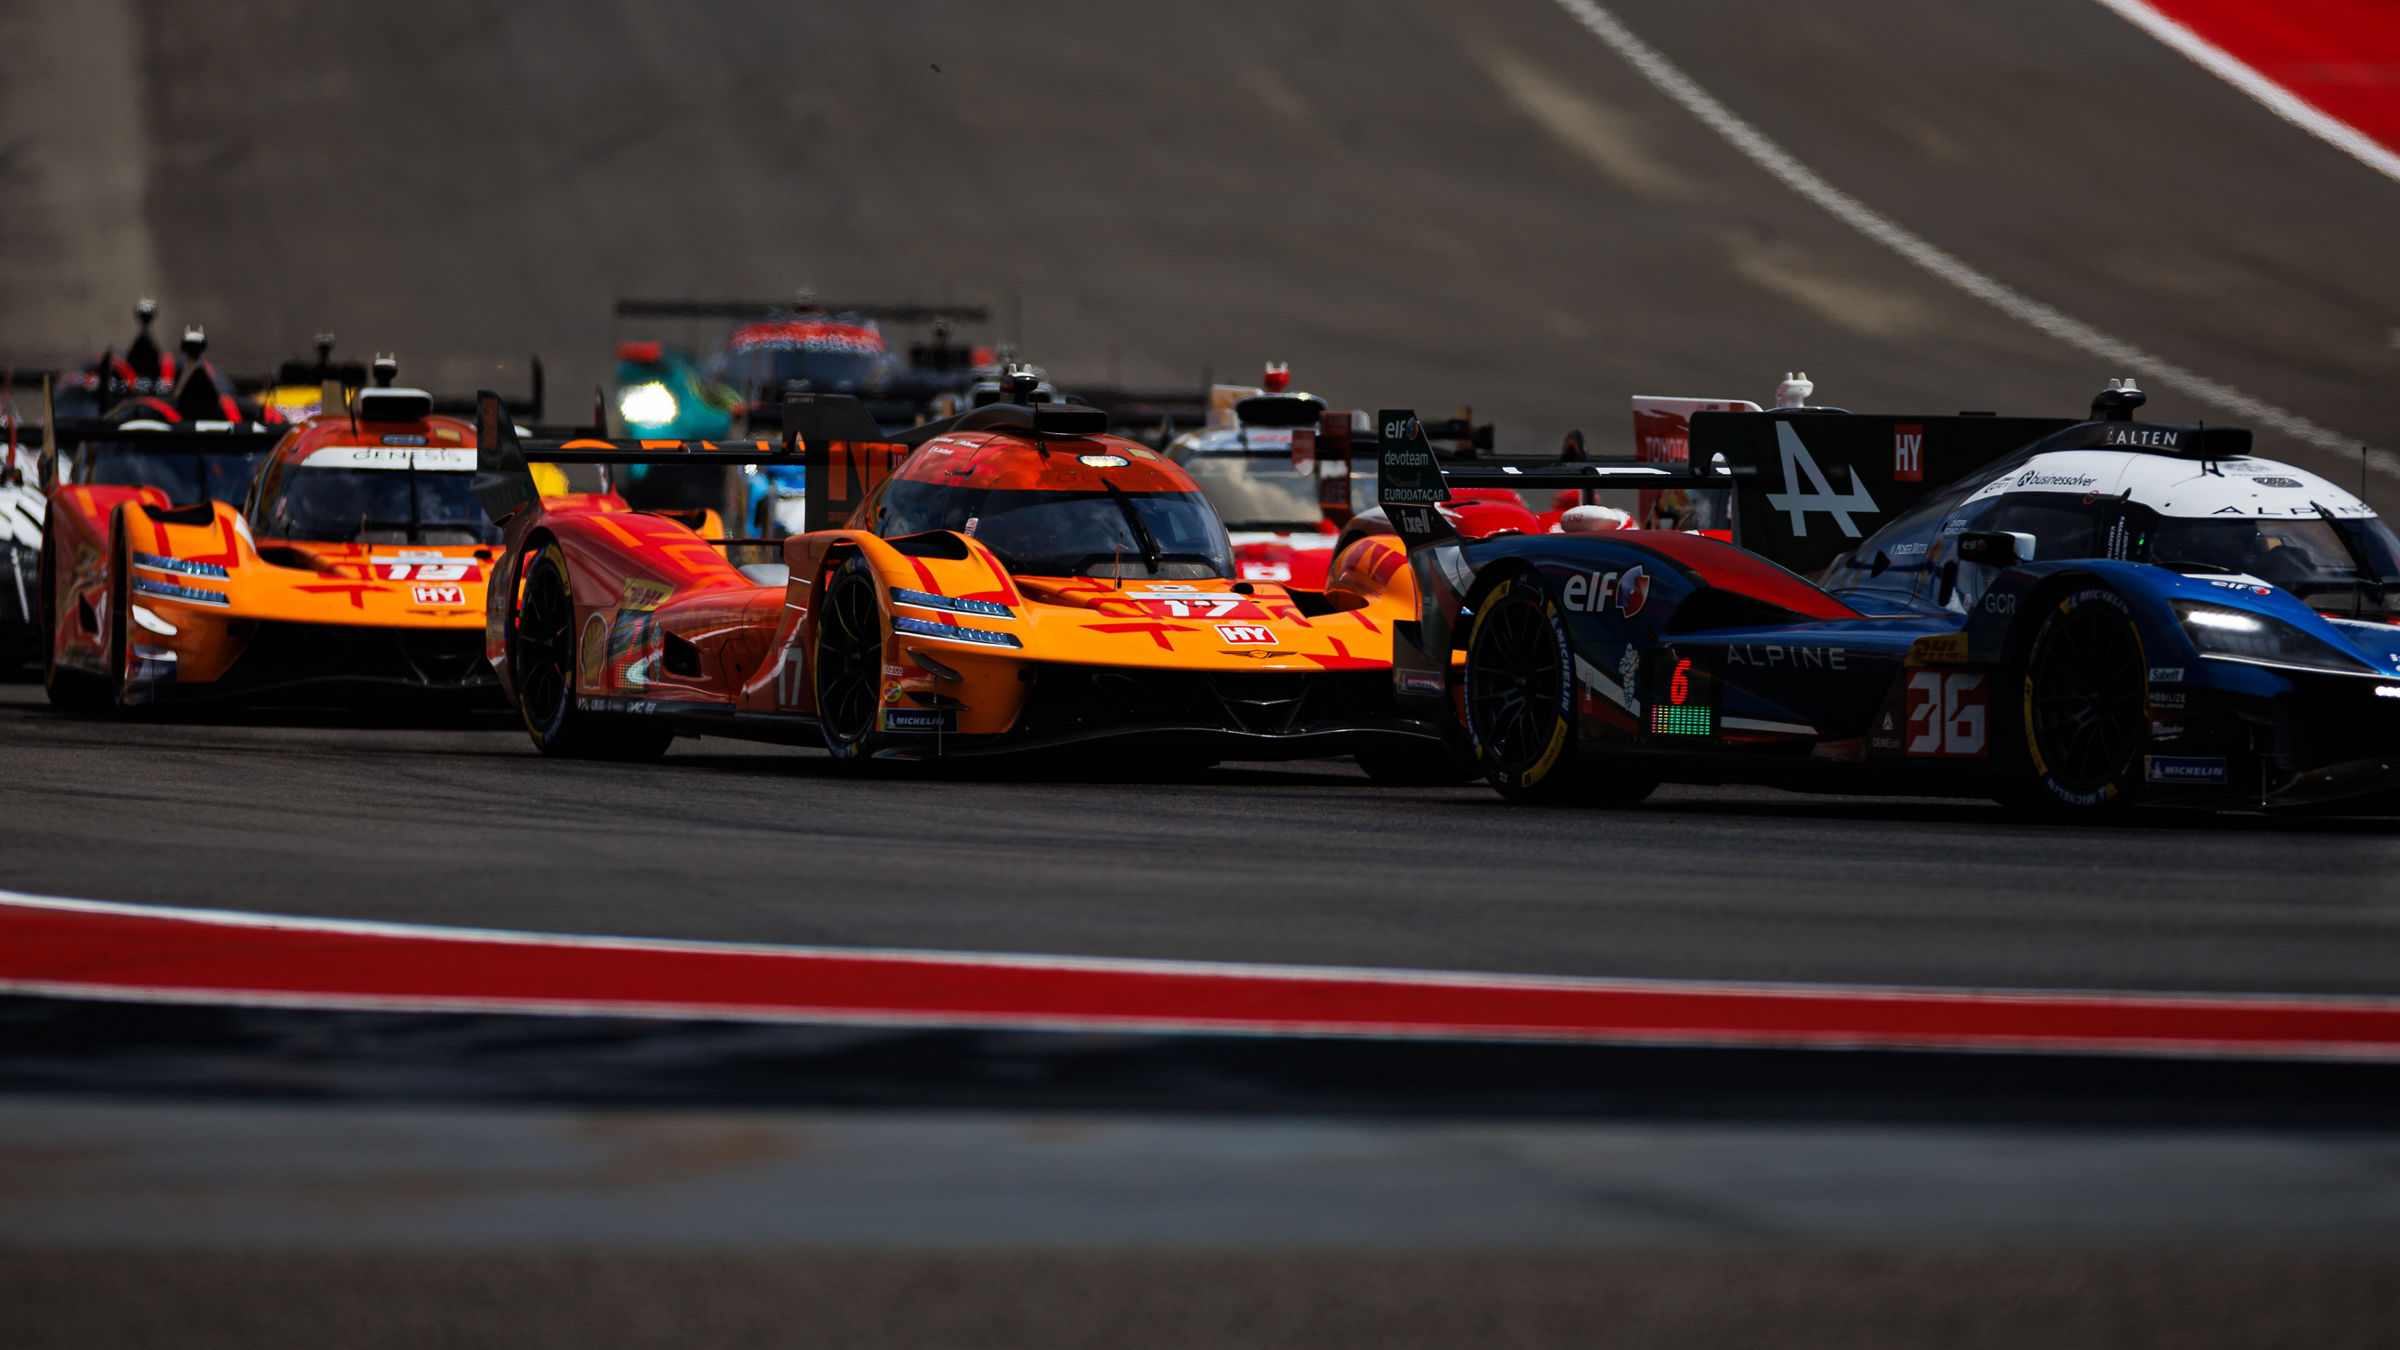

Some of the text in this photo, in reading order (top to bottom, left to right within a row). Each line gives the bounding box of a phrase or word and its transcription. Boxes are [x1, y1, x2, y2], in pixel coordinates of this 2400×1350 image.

[1385, 420, 1406, 439] elf
[2116, 430, 2178, 446] ALTEN
[1384, 450, 1428, 466] devoteam
[1895, 434, 1922, 471] HY
[2029, 472, 2098, 487] businessolver
[1384, 488, 1444, 500] EURODATACAR
[2212, 500, 2375, 515] ALPNE
[417, 588, 457, 601] HY
[1563, 571, 1617, 612] elf
[1163, 600, 1240, 617] 17
[1984, 593, 2016, 614] GCR
[1221, 626, 1266, 641] HY
[1726, 644, 1848, 671] ALPINE
[1912, 640, 1962, 659] DHL
[1555, 628, 1571, 712] MICHELIN
[1670, 657, 1692, 705] 6
[895, 717, 945, 725] MICHELIN
[1908, 672, 1987, 754] 36
[2163, 766, 2224, 776] MICHELIN
